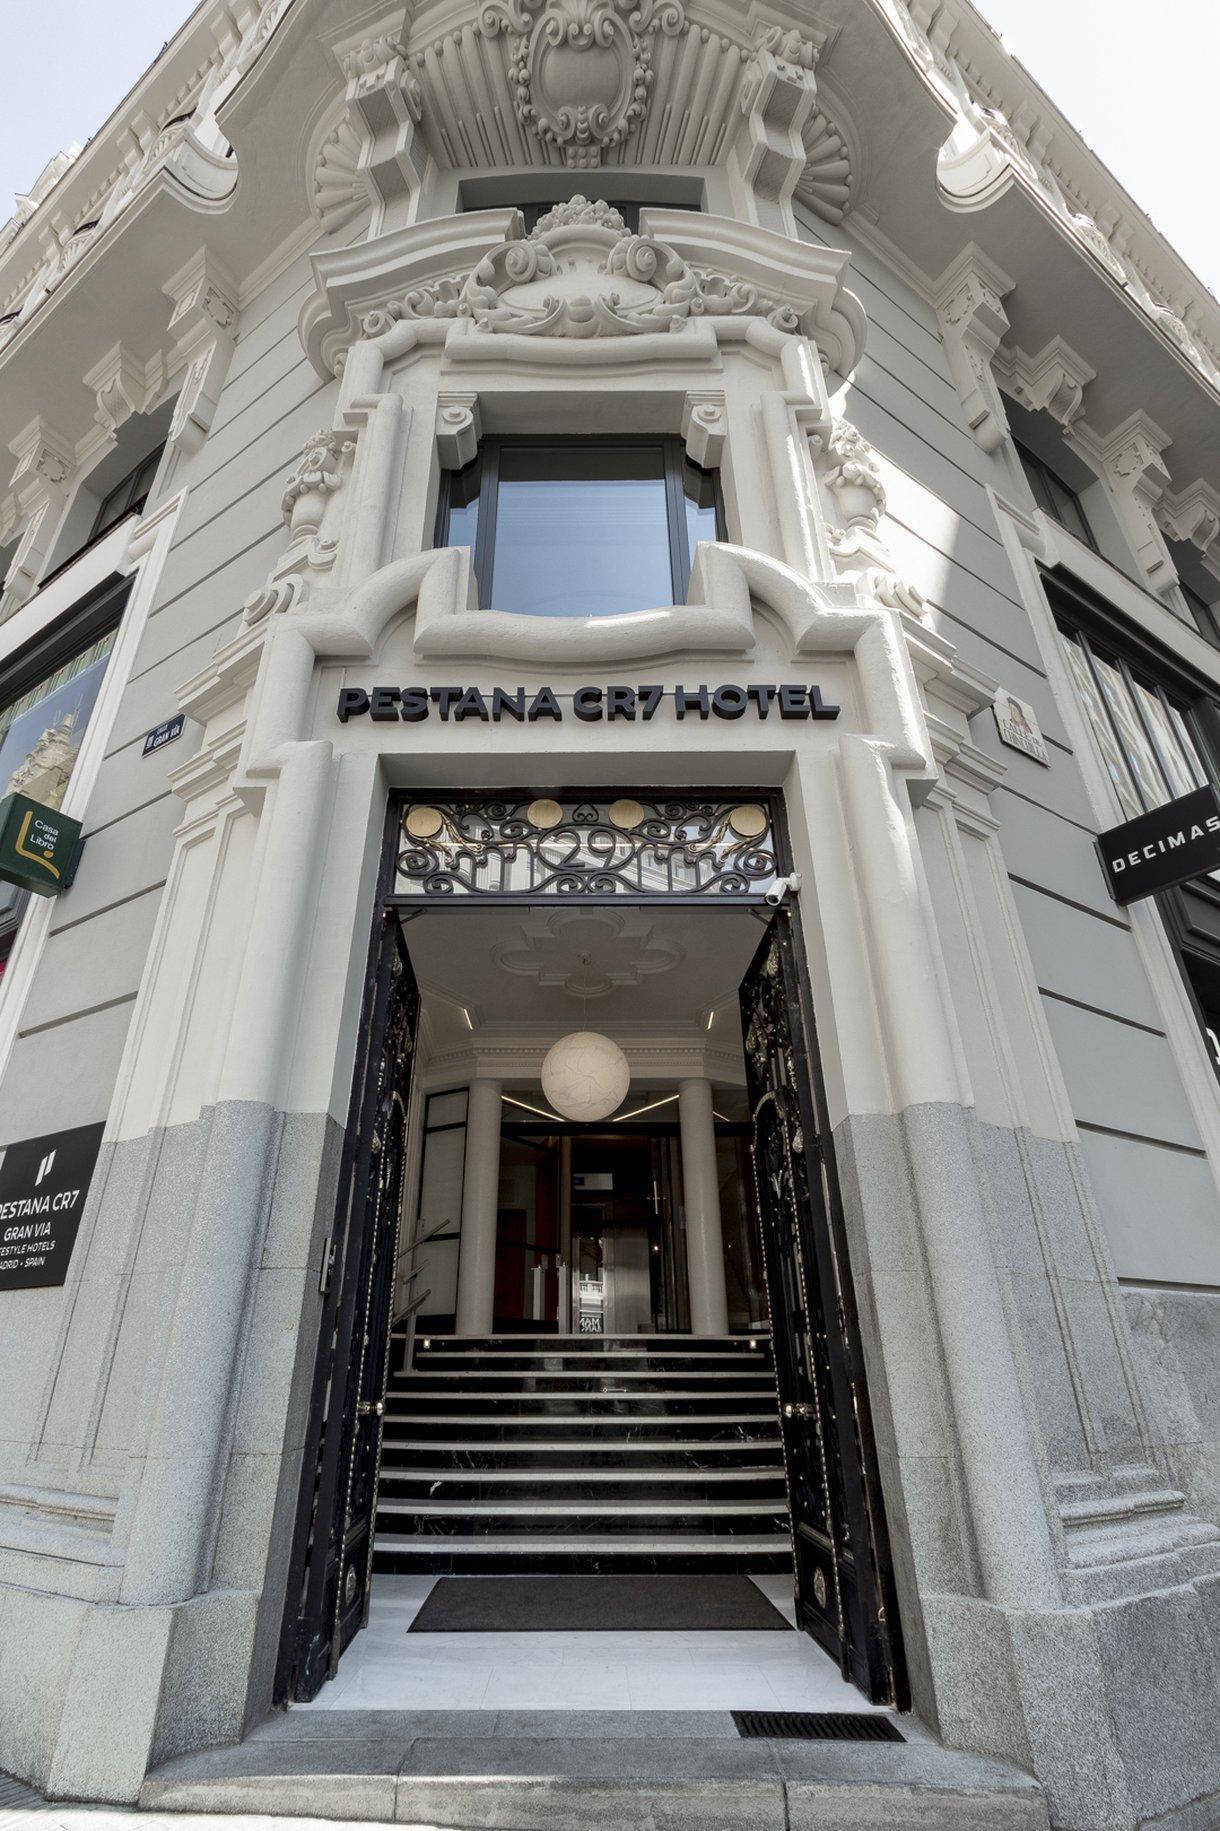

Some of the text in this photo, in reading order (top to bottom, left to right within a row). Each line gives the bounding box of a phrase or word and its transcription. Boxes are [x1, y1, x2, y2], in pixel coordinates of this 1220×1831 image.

[337, 684, 841, 723] PESTANA CR7 HOTEL
[153, 730, 170, 747] GRAN
[34, 819, 59, 836] Casa
[30, 834, 54, 851] Libro
[43, 832, 57, 843] del
[1112, 816, 1220, 873] DECIMAS
[52, 1189, 80, 1211] CR7
[4, 1221, 51, 1241] GRAN VIA
[0, 1240, 56, 1256] ESTYLE HOTELS
[24, 1256, 46, 1268] SPAIN
